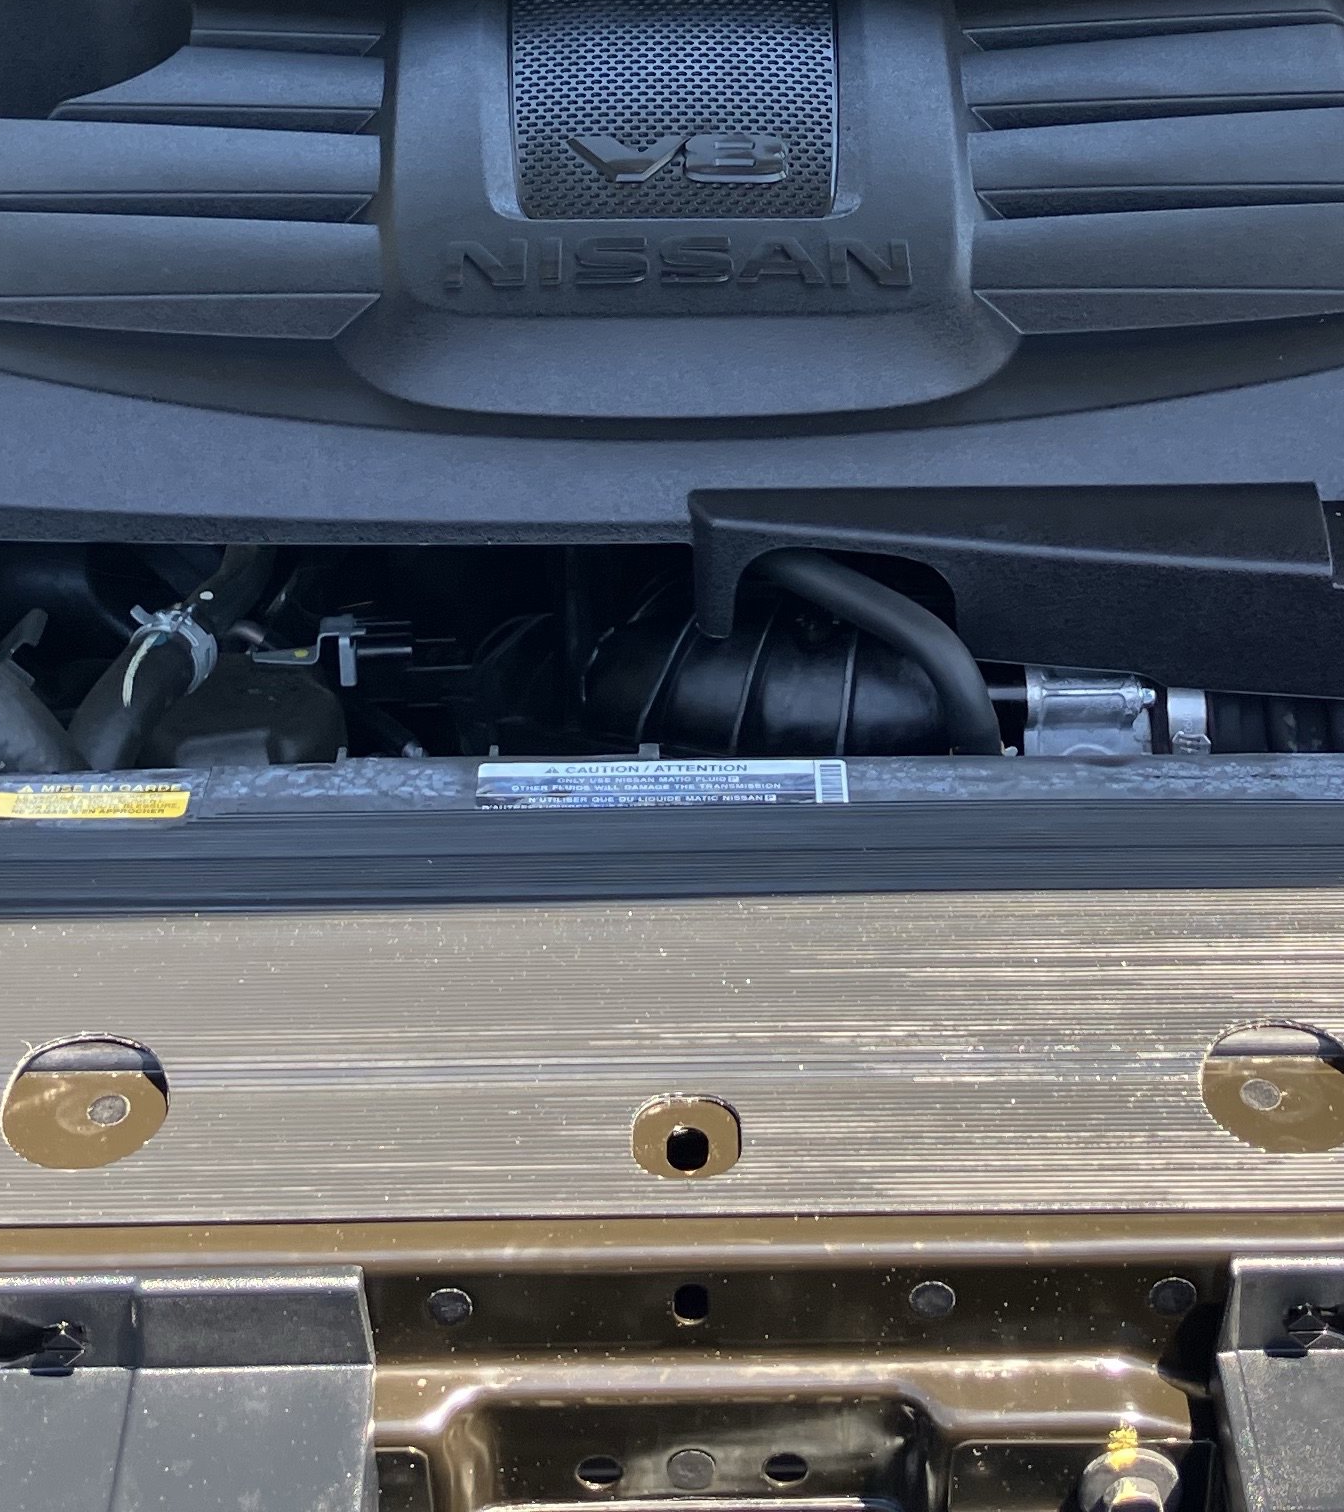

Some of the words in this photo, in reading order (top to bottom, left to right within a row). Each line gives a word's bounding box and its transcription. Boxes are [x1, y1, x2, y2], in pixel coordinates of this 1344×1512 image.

[567, 135, 788, 183] V8
[444, 236, 913, 289] NISSAN
[565, 765, 639, 773] CAUTION
[655, 764, 747, 772] ATTENTION
[41, 784, 83, 793] MISE
[89, 784, 113, 792] EN
[119, 783, 182, 792] GARDE
